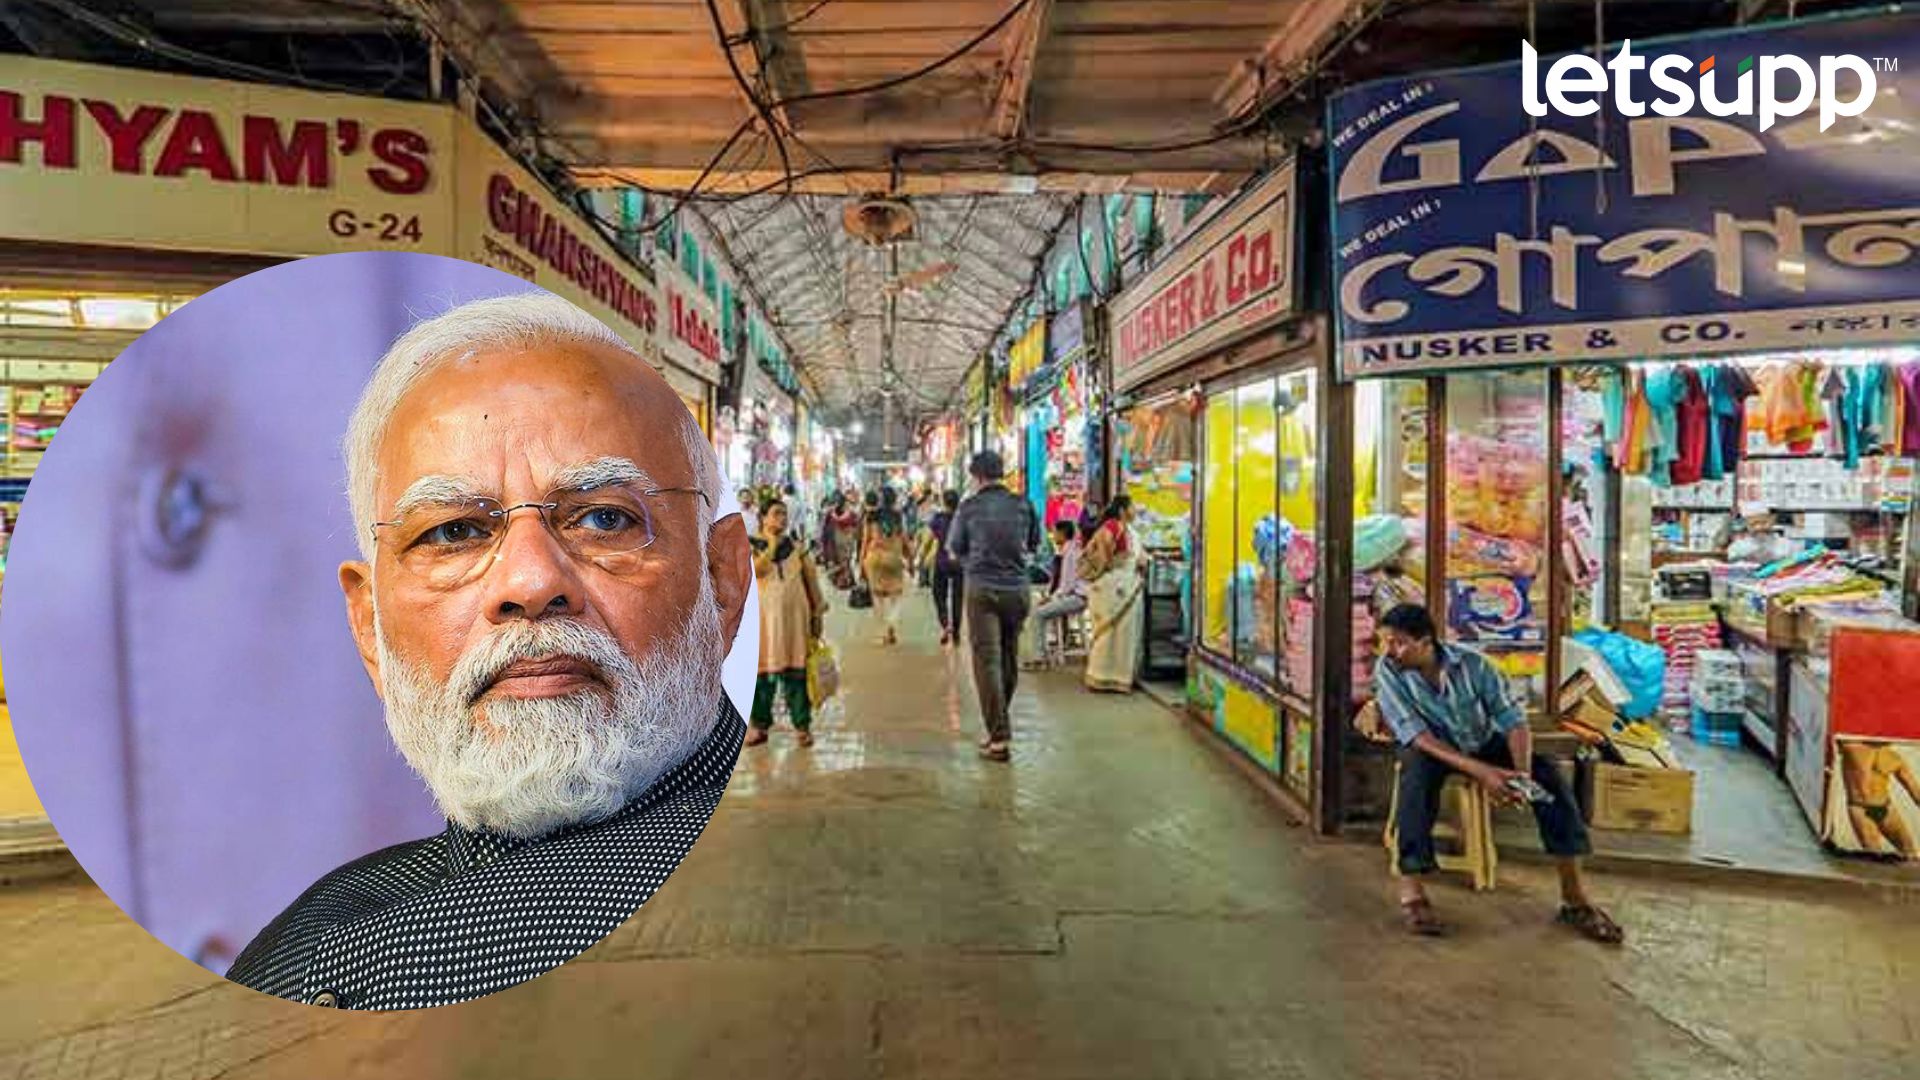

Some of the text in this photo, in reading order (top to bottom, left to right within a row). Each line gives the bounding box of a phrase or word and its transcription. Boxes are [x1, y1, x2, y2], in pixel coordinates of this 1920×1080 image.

[1356, 100, 1402, 130] DEAL
[328, 208, 422, 244] G-24
[1364, 214, 1410, 243] DEAL
[1200, 257, 1220, 320] &
[1361, 320, 1746, 364] NUSKER & CO.
